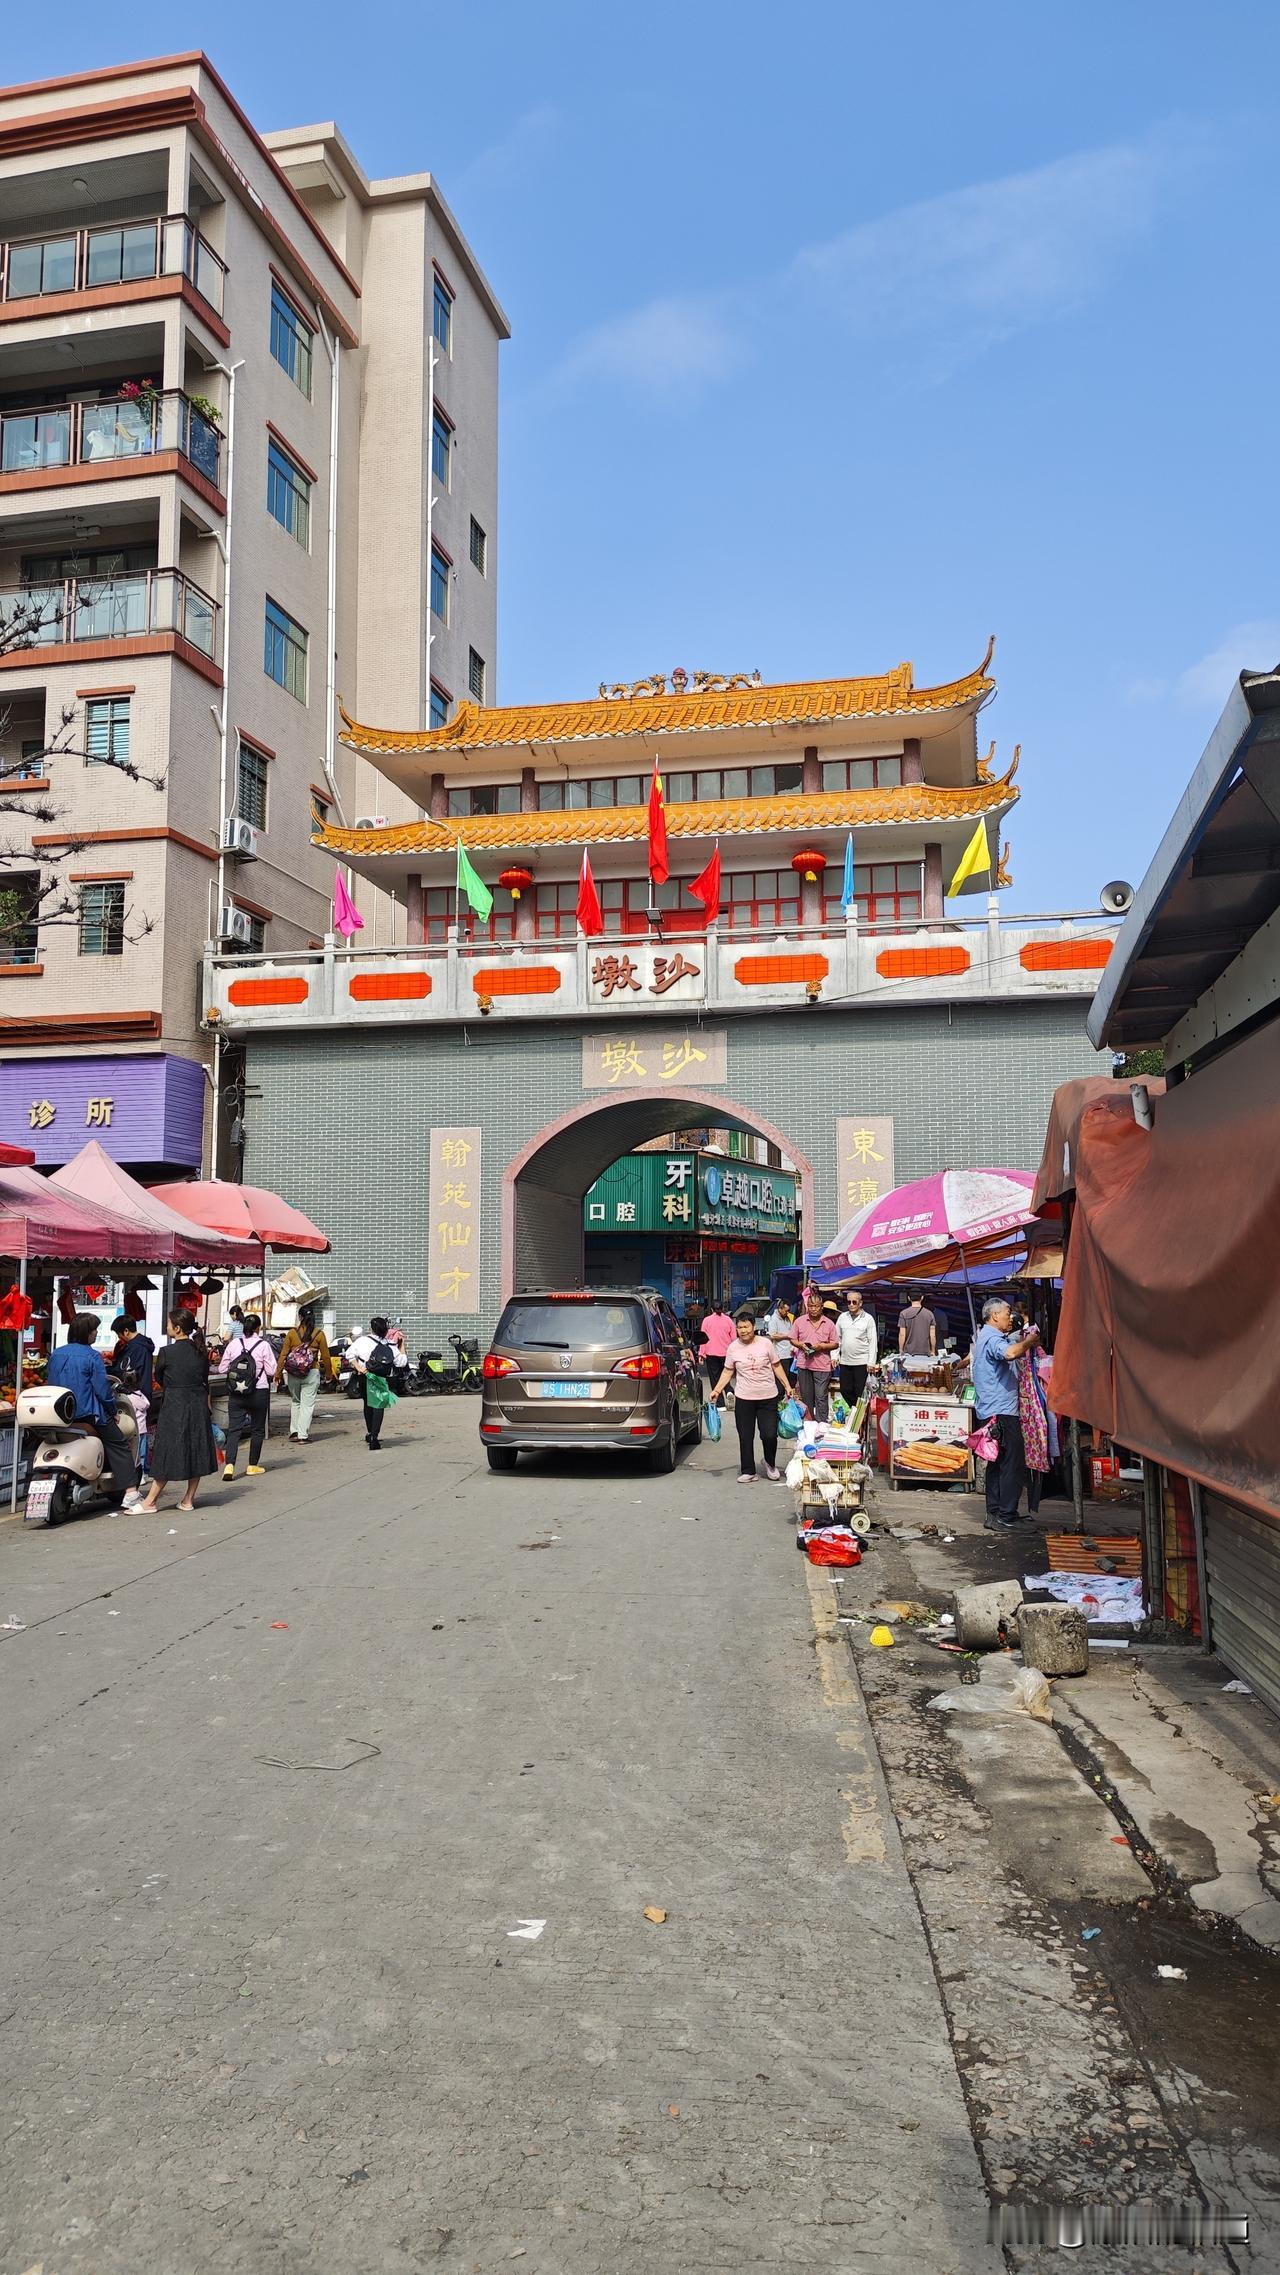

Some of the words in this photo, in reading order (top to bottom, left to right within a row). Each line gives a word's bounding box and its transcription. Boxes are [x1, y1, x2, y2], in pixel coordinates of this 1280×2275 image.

[28, 1096, 115, 1129] 诊所
[662, 1160, 693, 1223] 牙科
[435, 1138, 473, 1303] 翰苑仙才
[588, 1202, 636, 1222] 口腔
[914, 1409, 950, 1421] 油条
